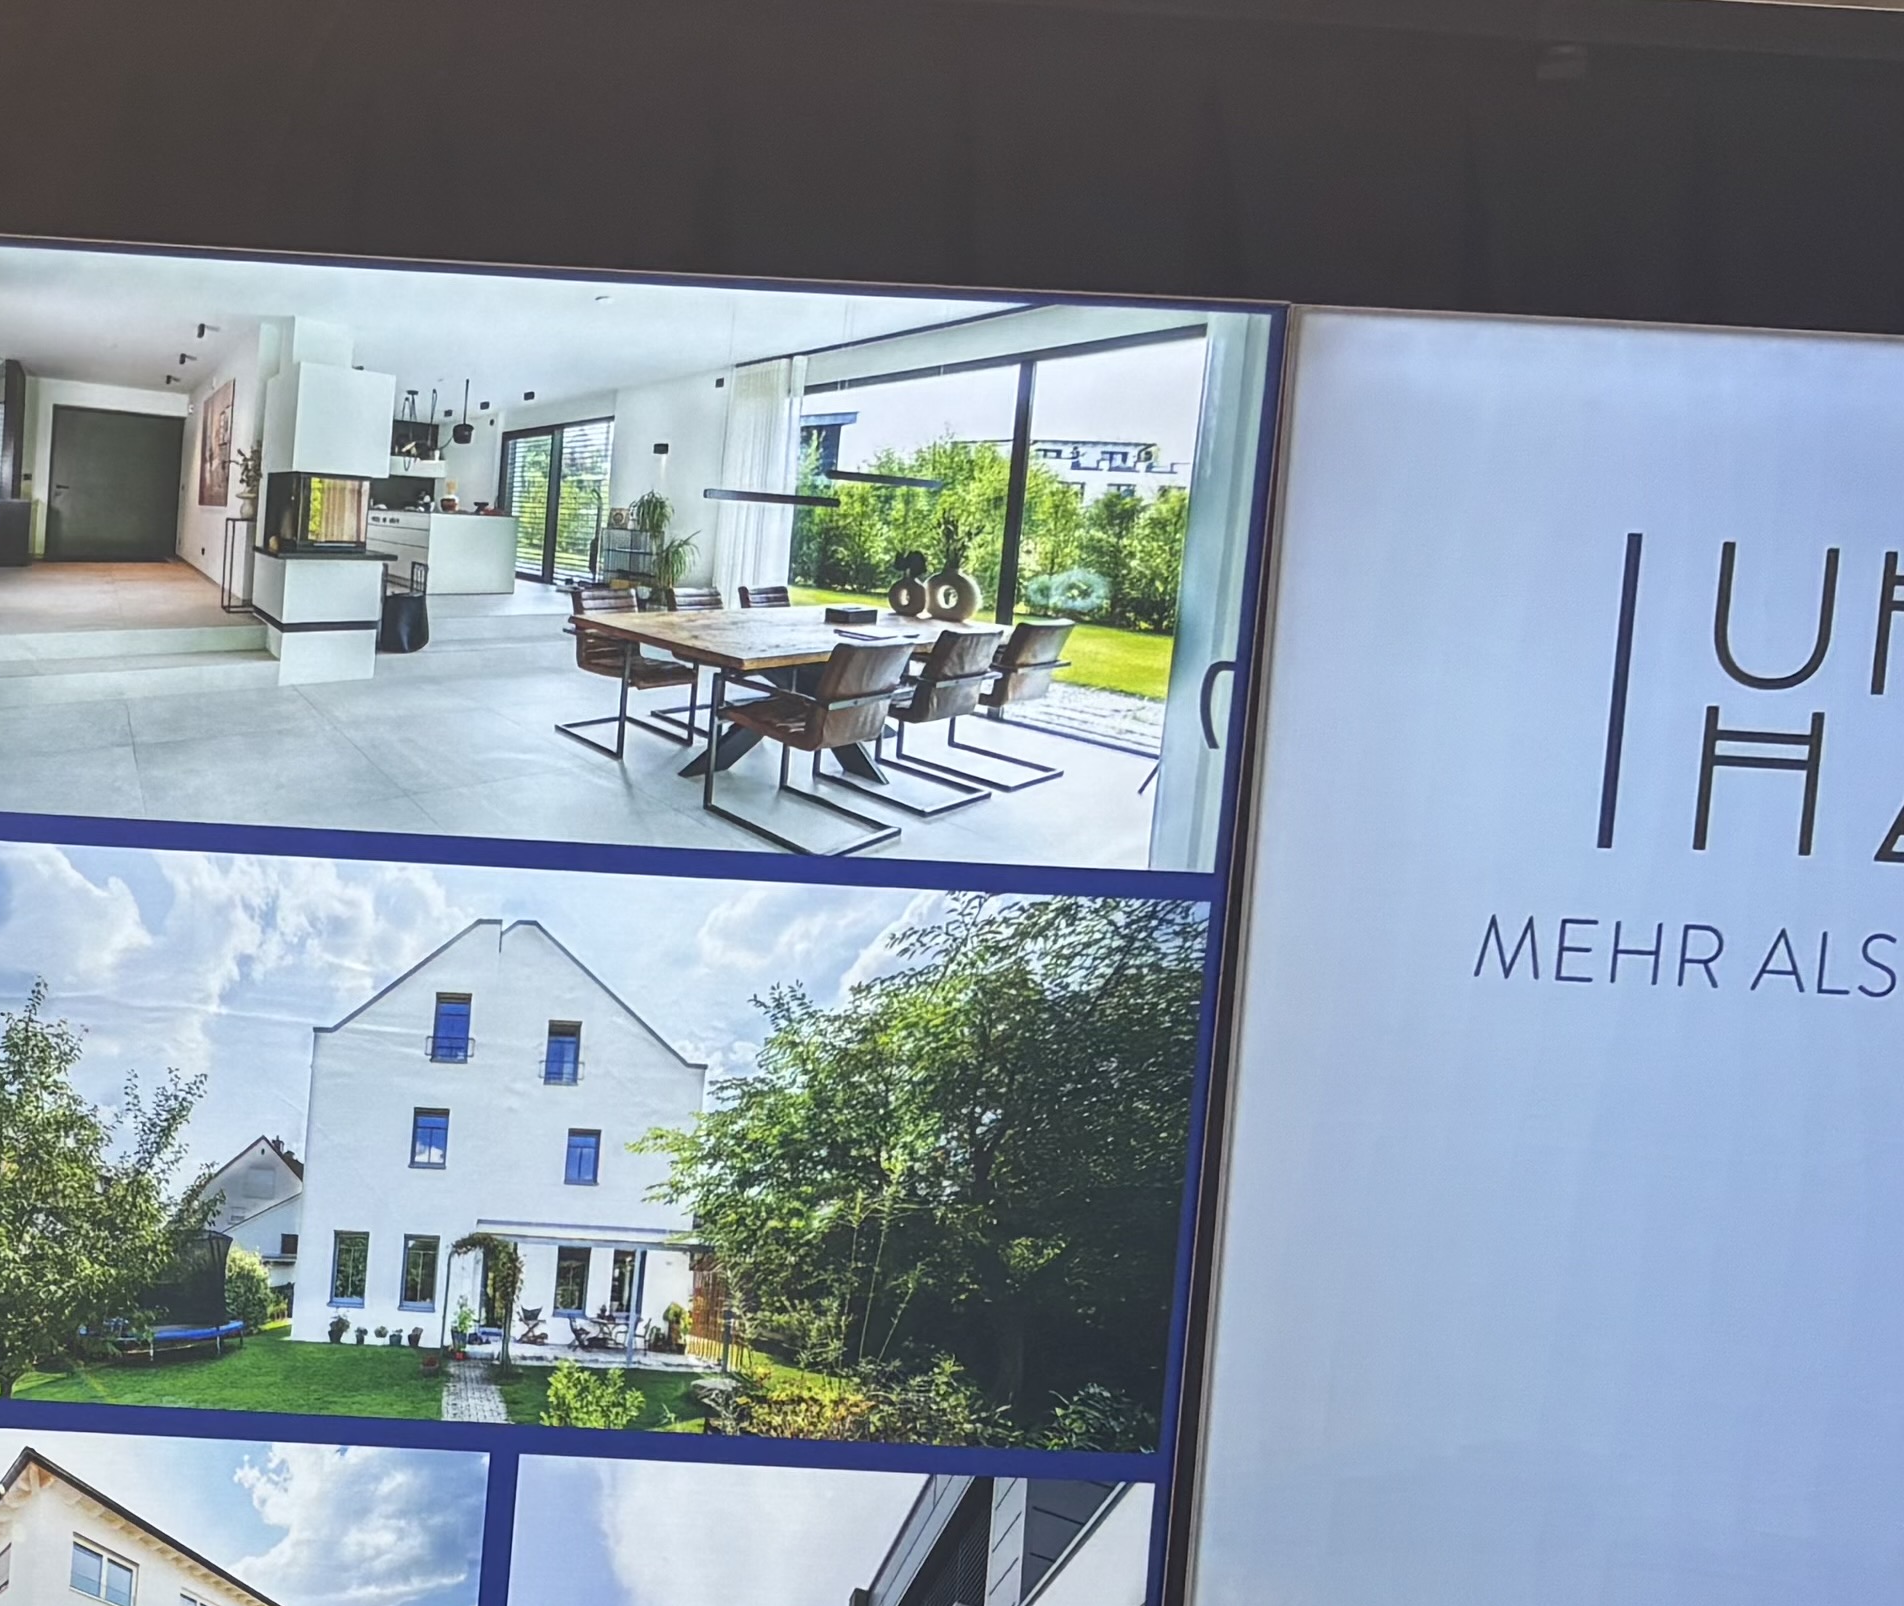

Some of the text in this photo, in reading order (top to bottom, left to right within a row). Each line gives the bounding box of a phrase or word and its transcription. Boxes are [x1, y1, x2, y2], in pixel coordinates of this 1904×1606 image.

[1714, 541, 1904, 695] U
[1474, 914, 1898, 998] MEHR ALS
